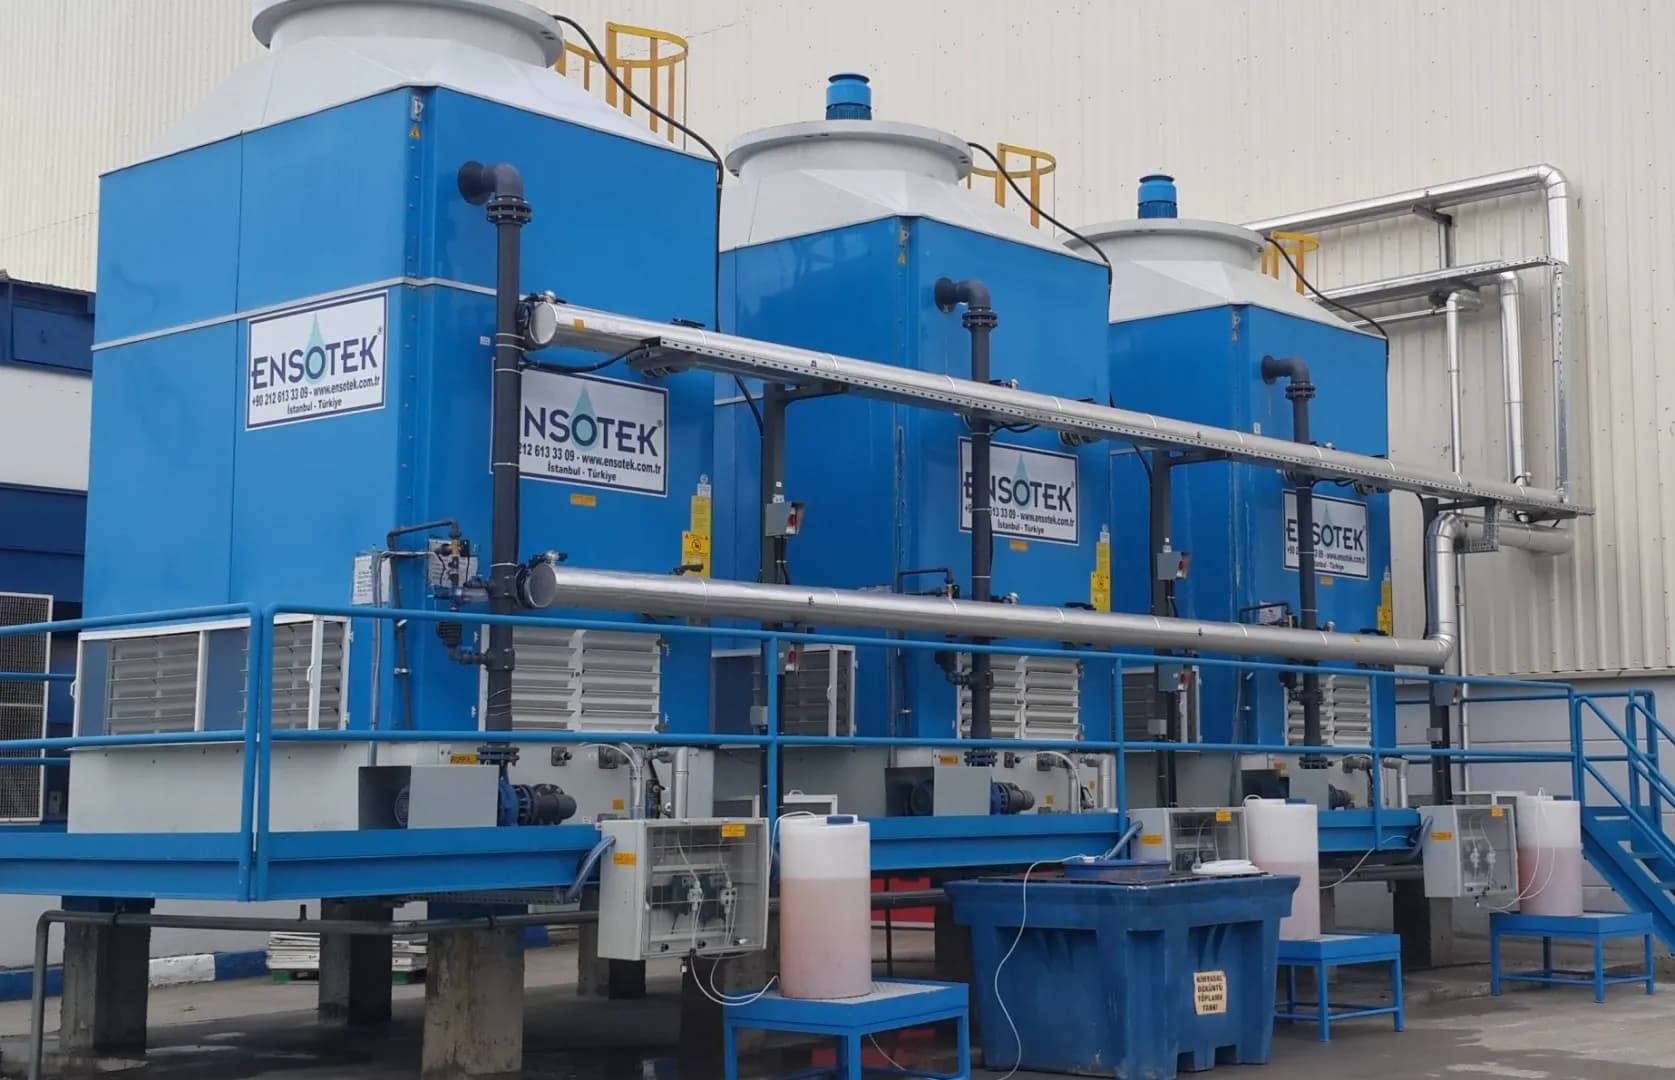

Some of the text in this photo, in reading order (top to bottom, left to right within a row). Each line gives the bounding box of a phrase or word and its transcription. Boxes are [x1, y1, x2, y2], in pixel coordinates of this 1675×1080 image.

[252, 335, 378, 389] ENSOTEK
[252, 393, 263, 407] +90
[265, 392, 276, 405] 212
[278, 390, 289, 404] 613
[291, 388, 299, 401] 33
[300, 386, 308, 399] 09
[313, 376, 380, 397] www.ensotek.com.tr
[287, 402, 313, 415] İstanbul
[318, 398, 342, 411] Türkiye
[524, 405, 658, 457] NSOTEK
[535, 444, 550, 458] 613
[552, 447, 562, 460] 33
[564, 449, 575, 462] 09
[581, 453, 662, 475] www.ensotek.com.tr
[547, 460, 580, 476] İstanbul
[588, 468, 617, 482] Türkiye
[1286, 519, 1364, 552] ESOTEK
